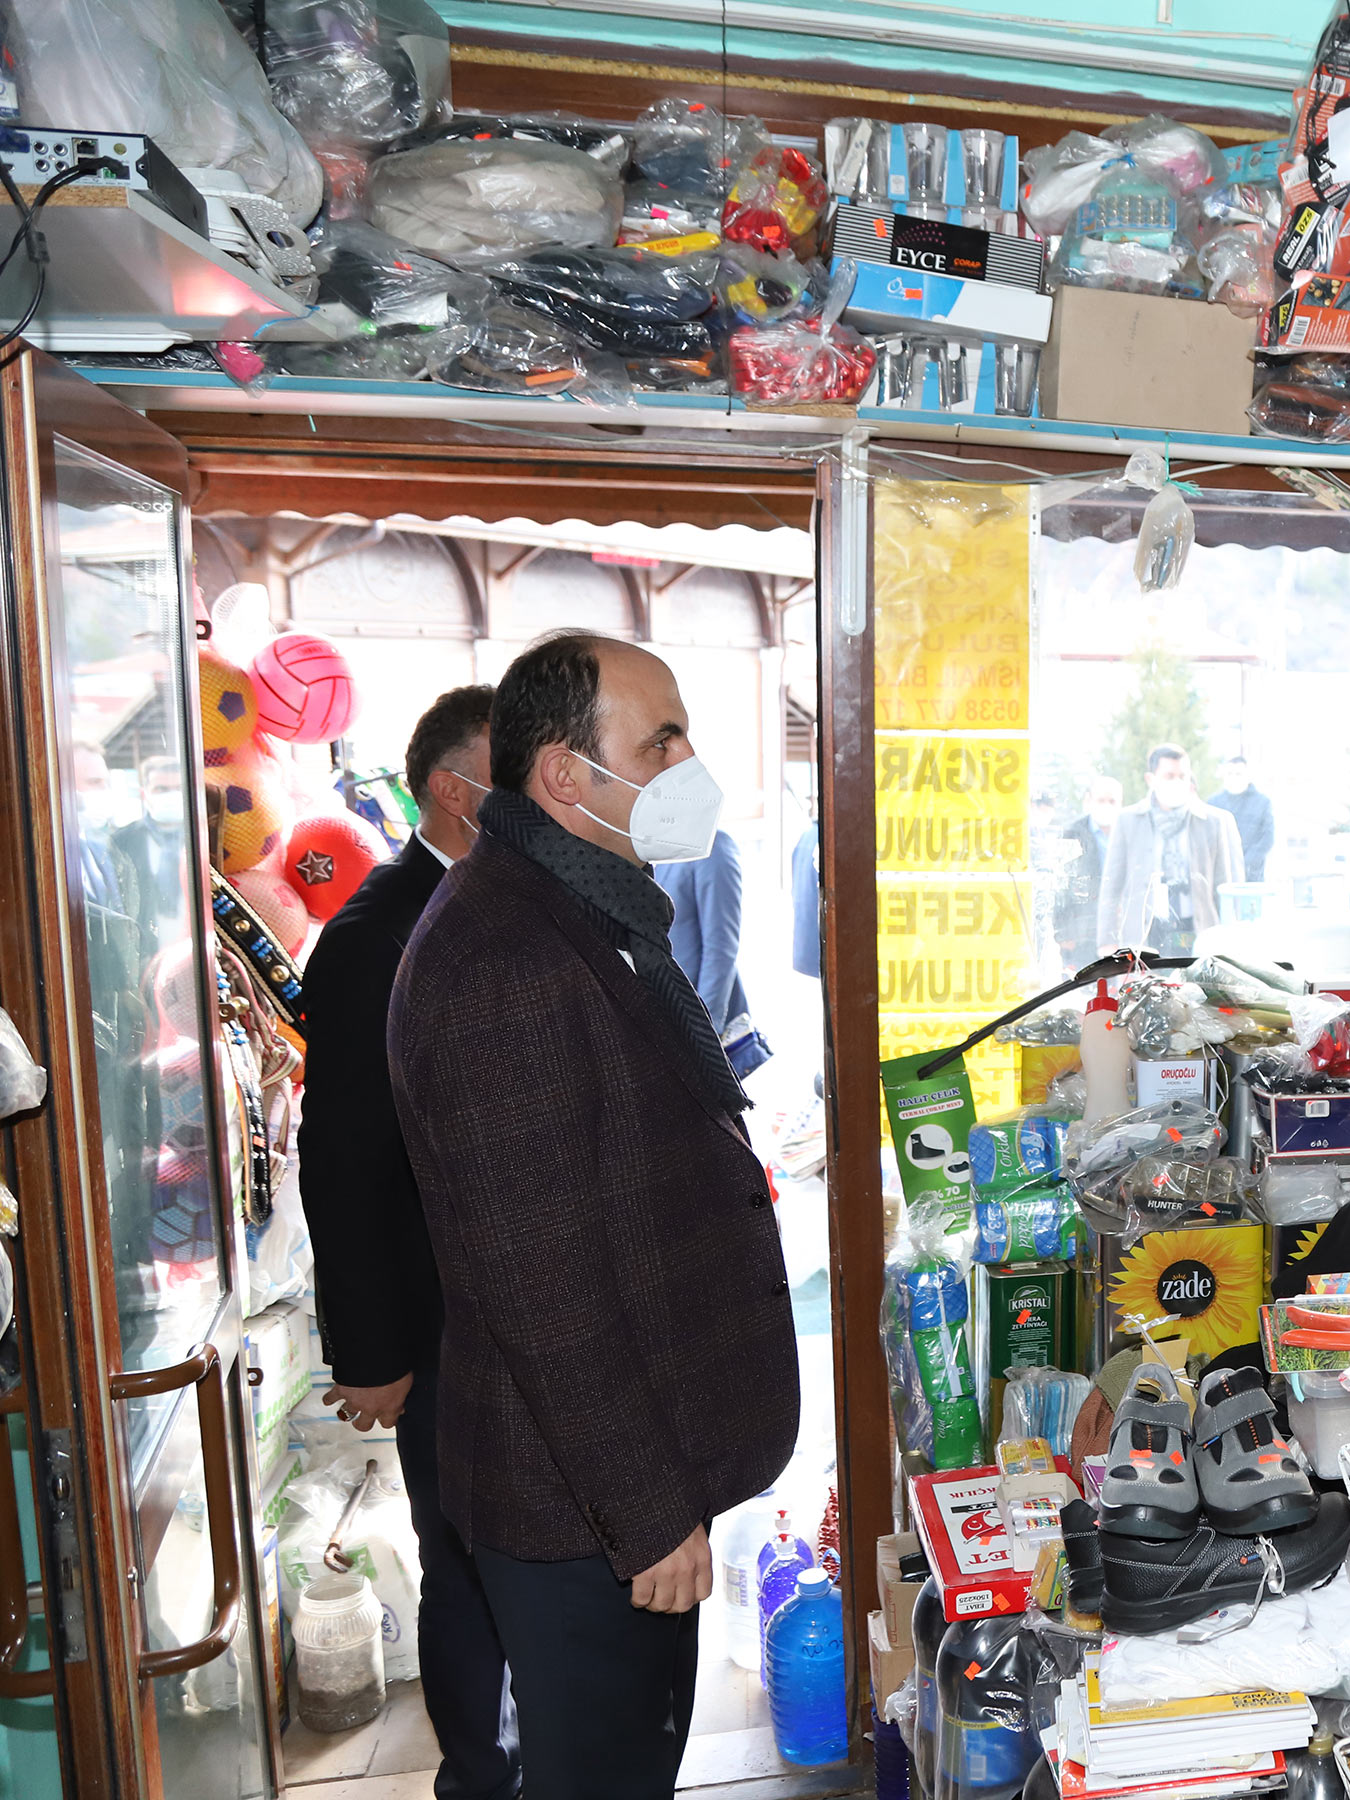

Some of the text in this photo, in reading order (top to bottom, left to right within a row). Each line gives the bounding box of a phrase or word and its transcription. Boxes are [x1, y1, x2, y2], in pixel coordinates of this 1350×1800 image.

[1282, 235, 1301, 264] REAL
[897, 246, 947, 271] EYCE
[1161, 1066, 1197, 1079] ORUÇOĞLU
[946, 1185, 961, 1198] 70
[1147, 1199, 1183, 1211] HUNTER
[1162, 1271, 1211, 1300] zade
[965, 1602, 985, 1611] EBAT
